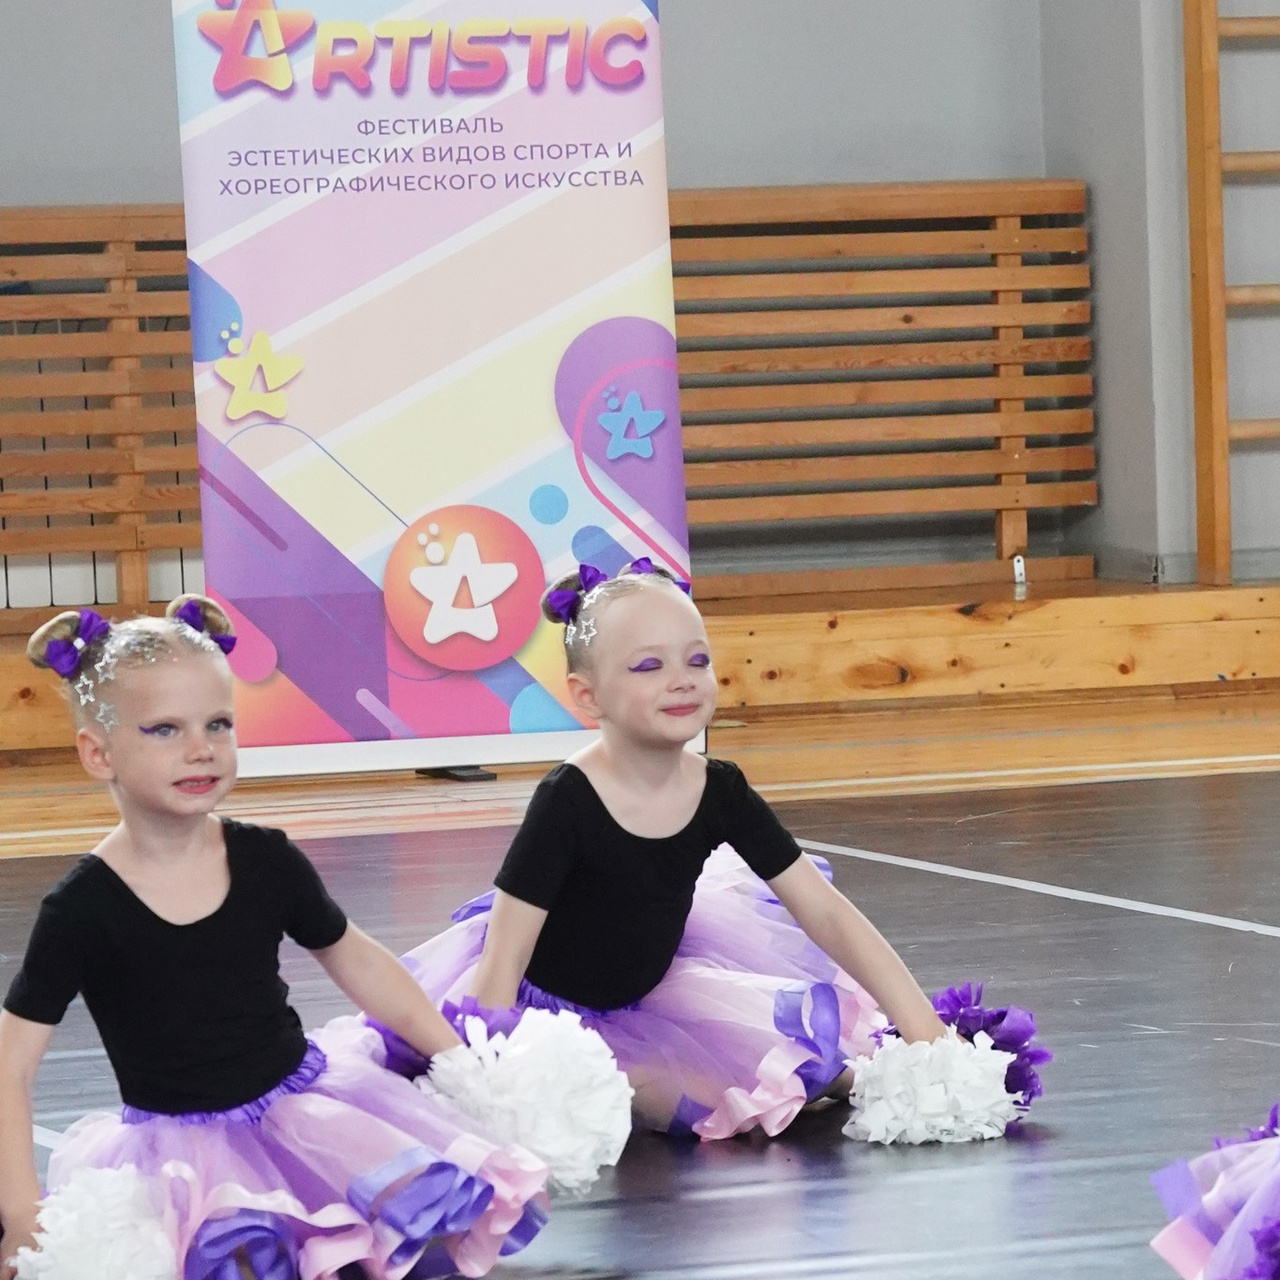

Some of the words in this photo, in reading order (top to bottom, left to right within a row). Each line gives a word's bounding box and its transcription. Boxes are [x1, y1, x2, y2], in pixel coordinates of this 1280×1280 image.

[356, 117, 504, 137] ФЕСТИВАЛЬ
[227, 145, 416, 168] ЭСТЕТИЧЕСКИХ
[422, 145, 507, 166] ВИДОВ
[512, 142, 611, 162] СПОРТА
[617, 141, 633, 159] И
[218, 172, 497, 197] ХОРЕОГРАФИЧЕСКОГО
[504, 169, 645, 190] ИСКУССТВА
